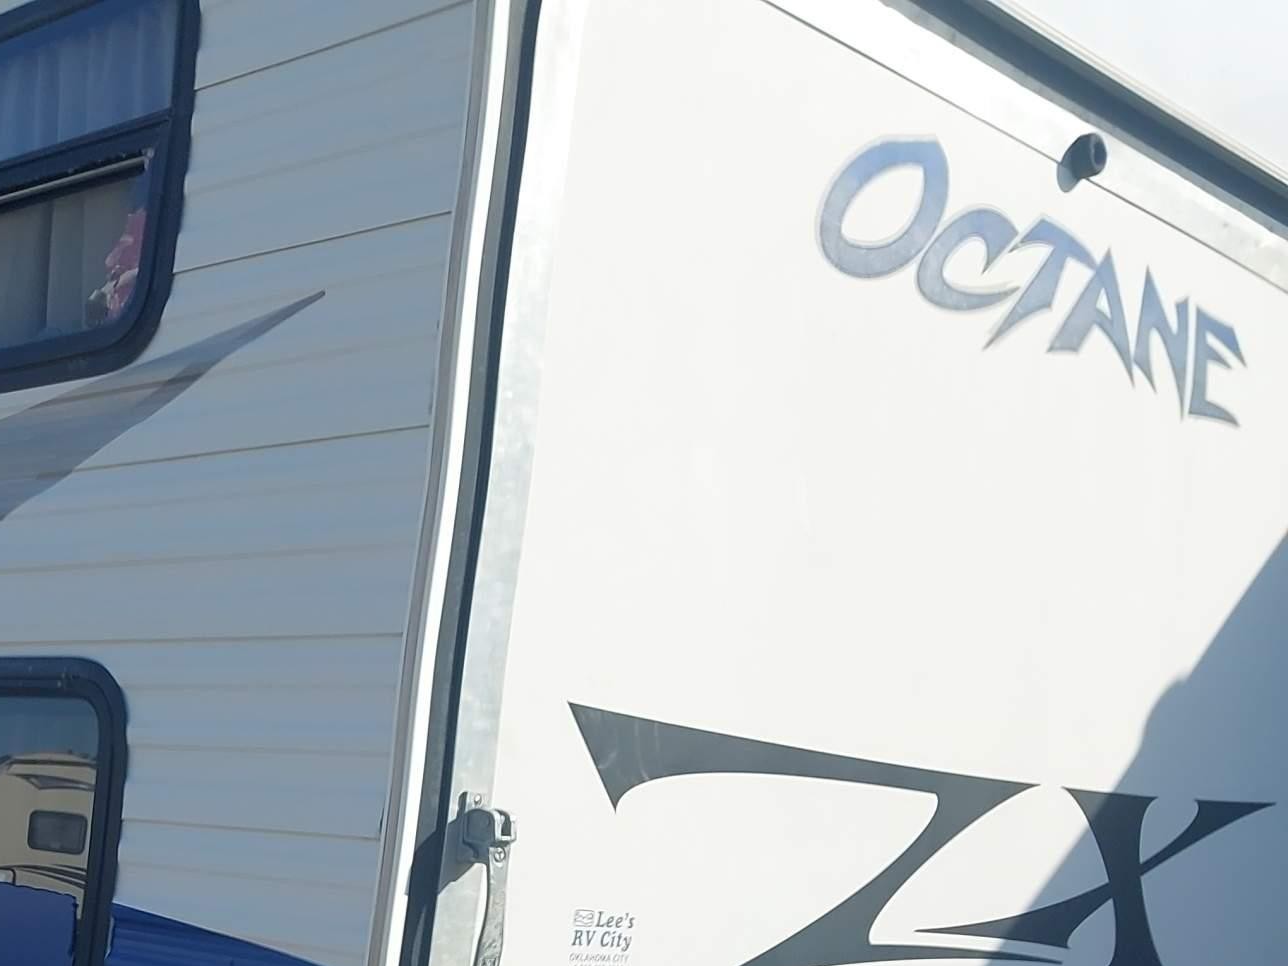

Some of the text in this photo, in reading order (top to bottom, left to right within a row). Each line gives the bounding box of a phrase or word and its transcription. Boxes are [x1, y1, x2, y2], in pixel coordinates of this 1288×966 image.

[816, 133, 1247, 428] OCTANE
[595, 911, 635, 929] Lee's
[571, 930, 632, 952] RV City
